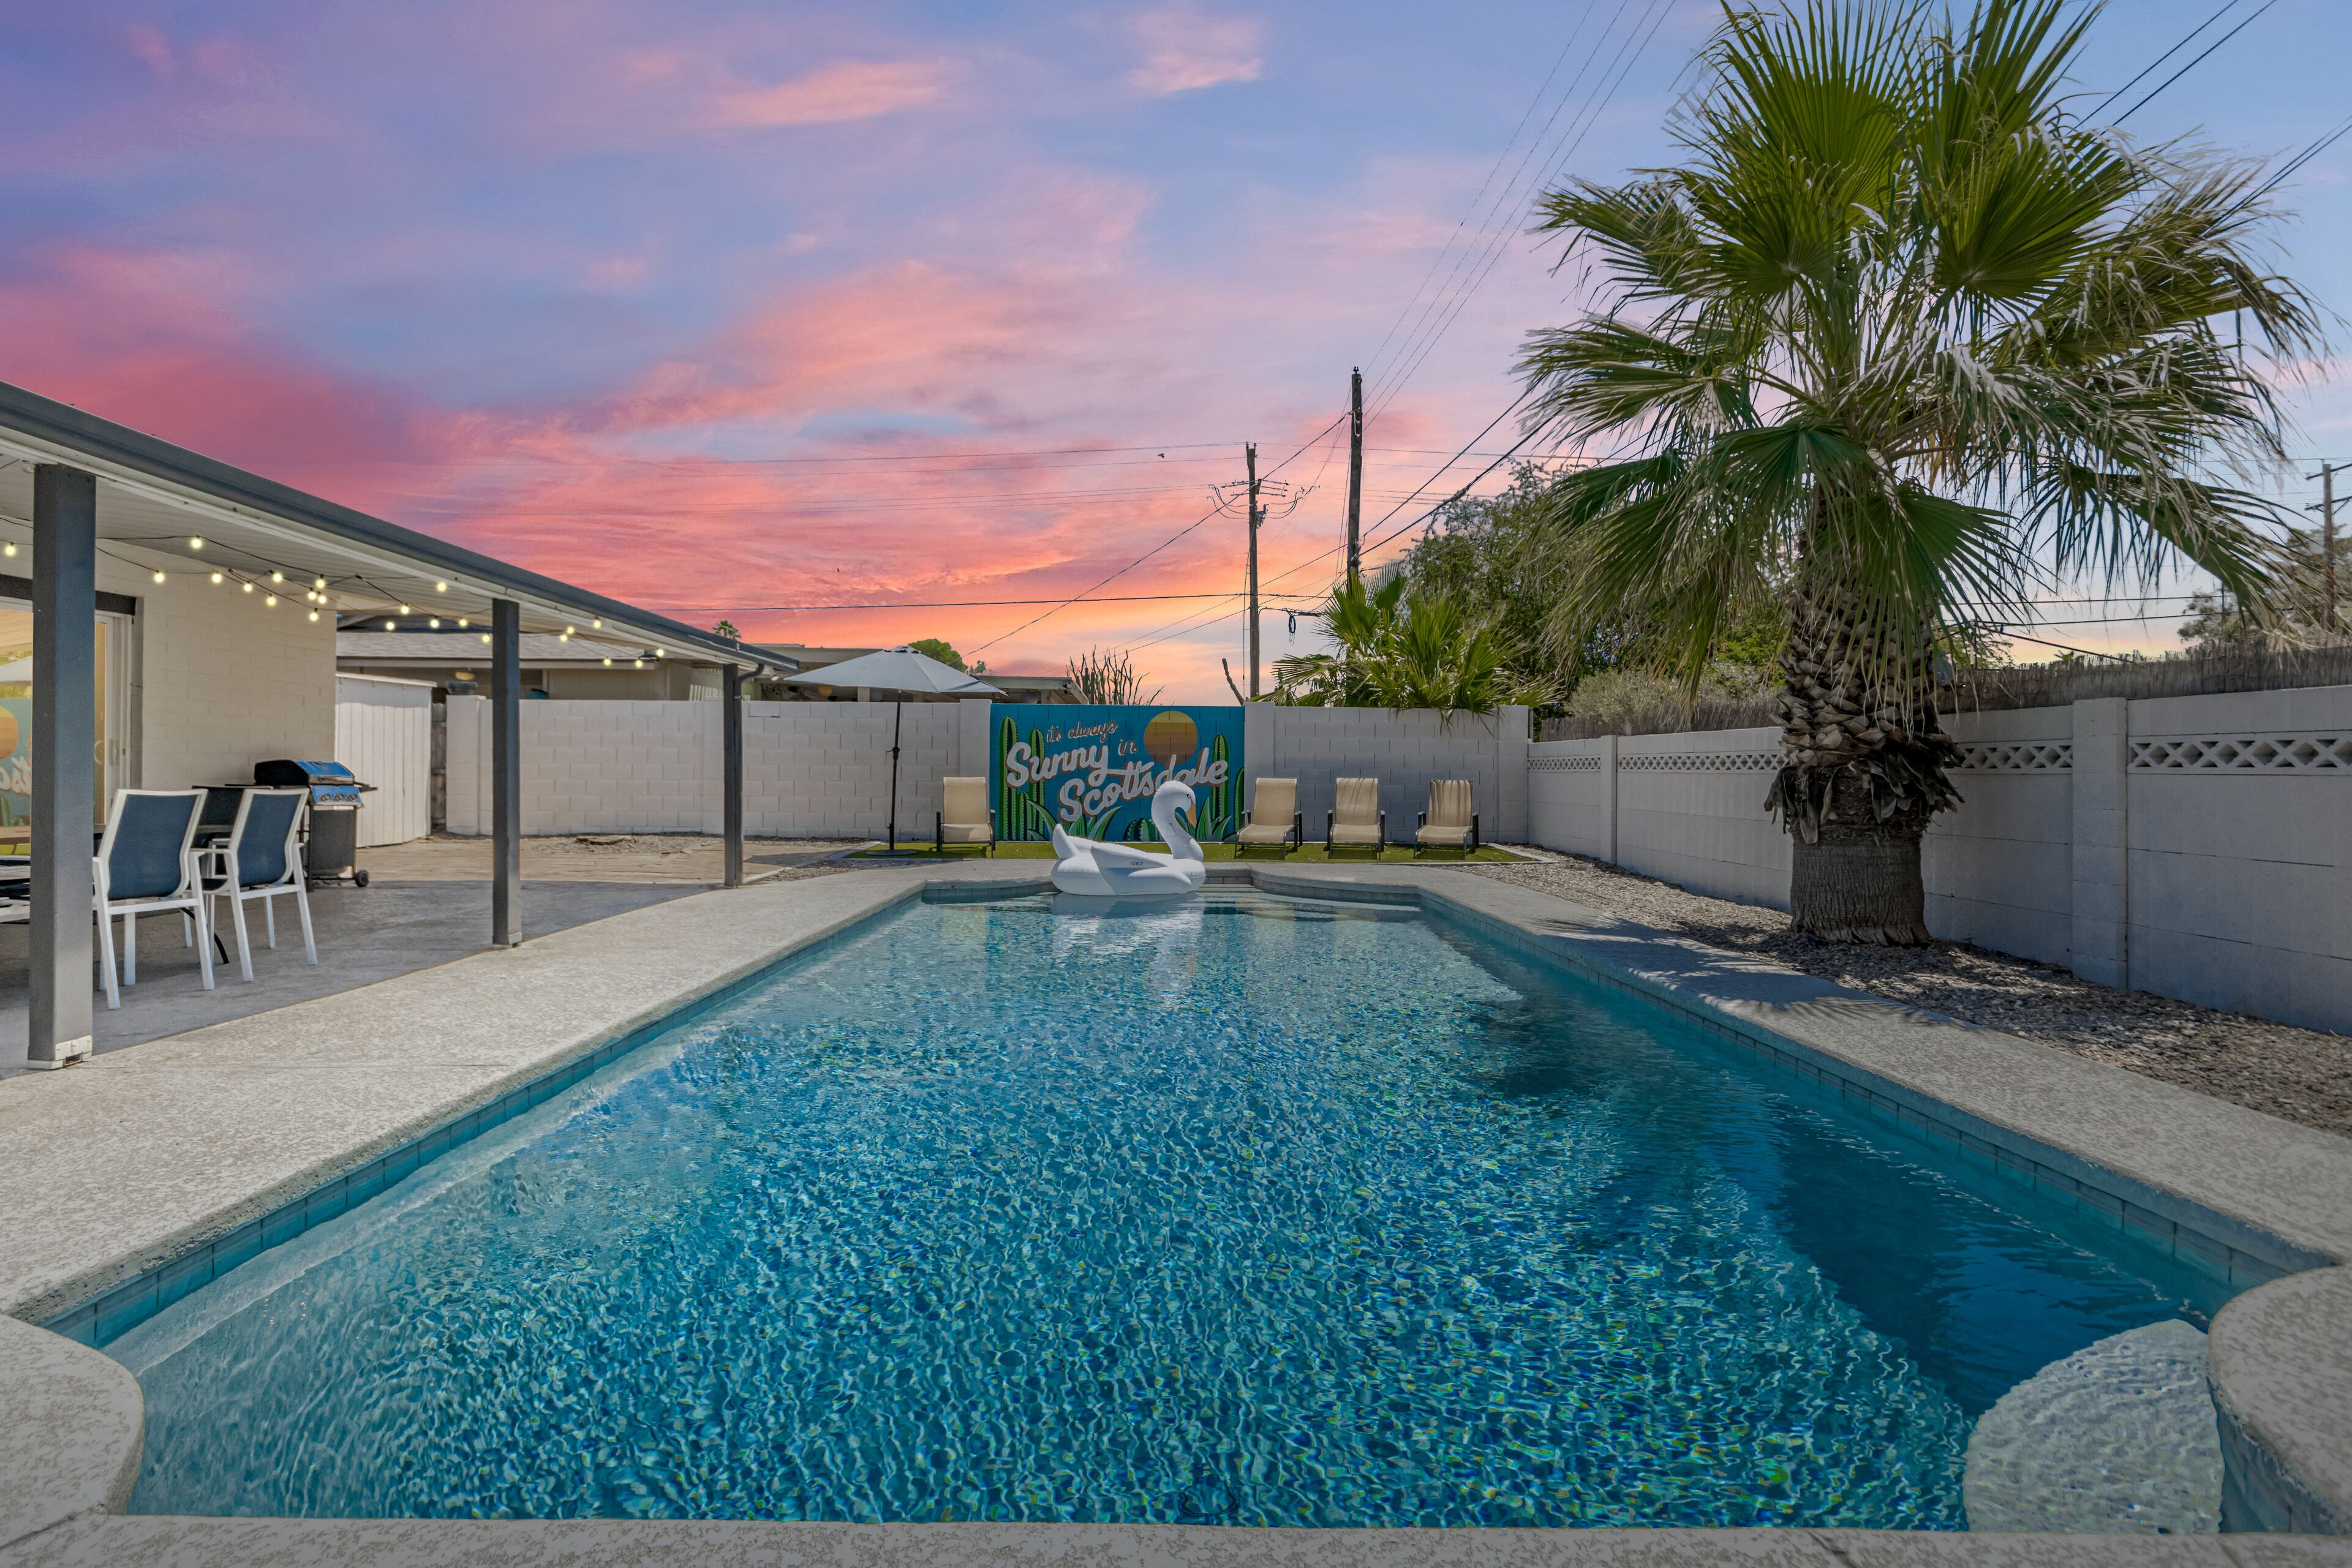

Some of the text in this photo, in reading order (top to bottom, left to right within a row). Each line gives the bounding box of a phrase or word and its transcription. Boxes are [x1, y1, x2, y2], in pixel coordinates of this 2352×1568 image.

[1046, 719, 1120, 743] it's always
[1005, 738, 1137, 788] Sunny in
[1057, 747, 1229, 824] Scottsdale
